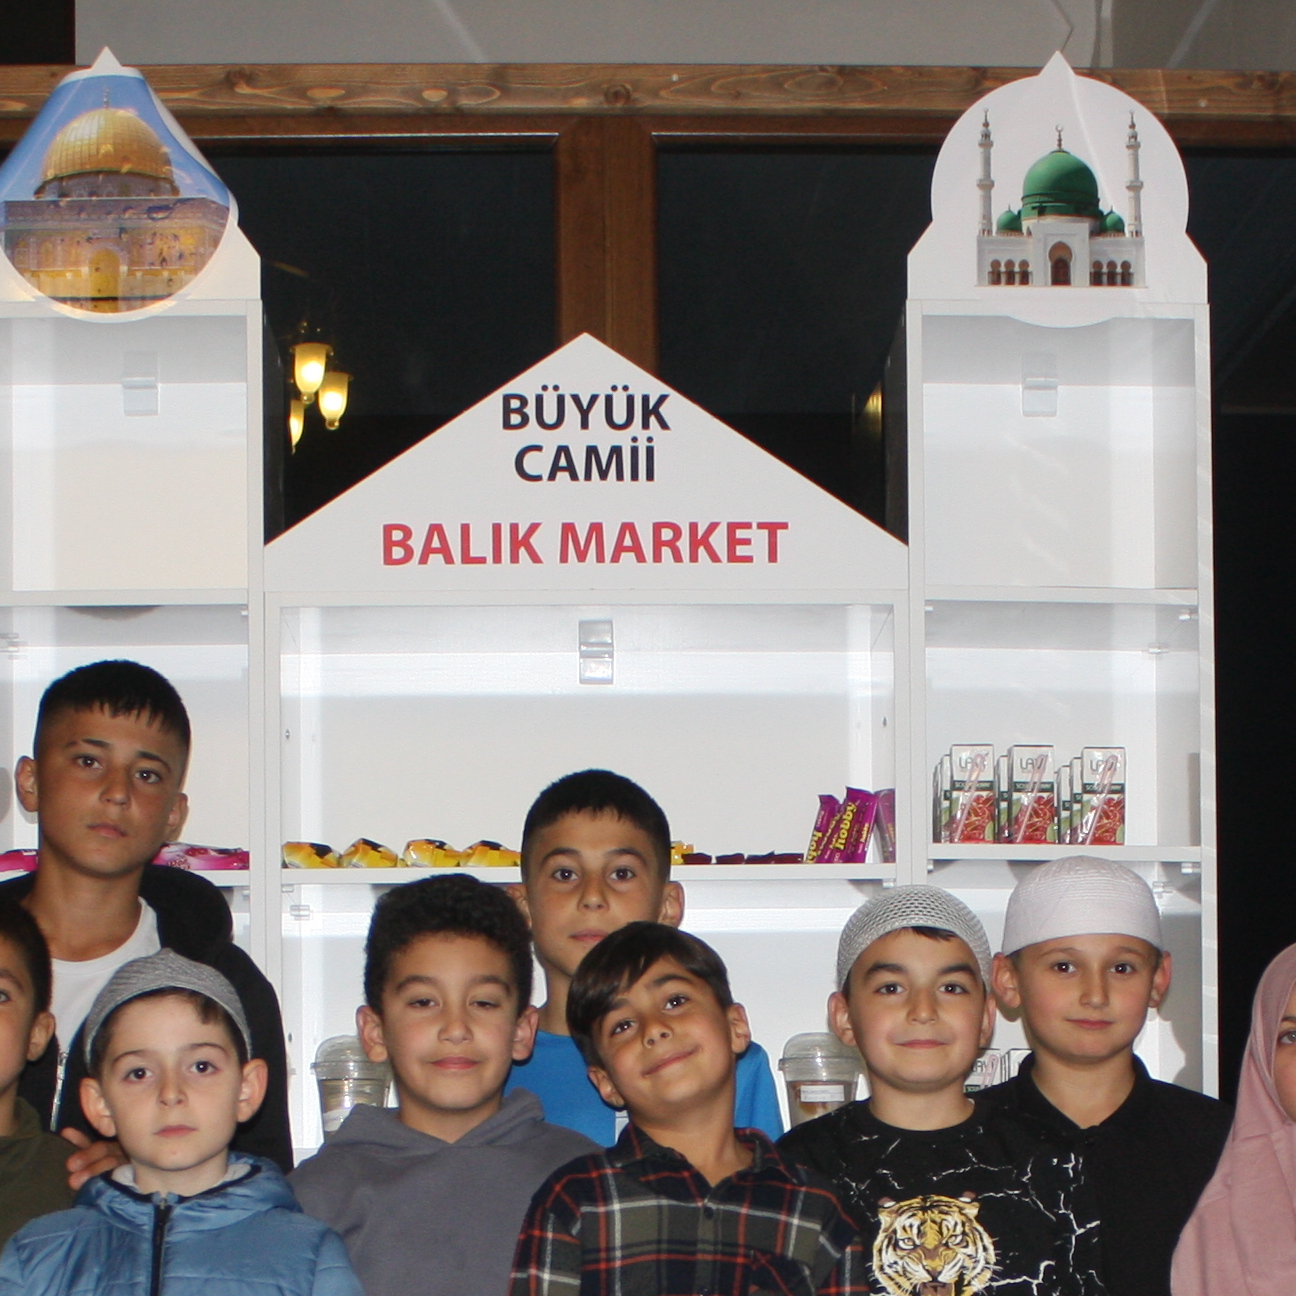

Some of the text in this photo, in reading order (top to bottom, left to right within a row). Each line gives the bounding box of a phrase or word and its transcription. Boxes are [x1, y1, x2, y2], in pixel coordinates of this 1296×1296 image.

[501, 384, 671, 430] BÜYÜK
[382, 521, 789, 566] BALIK MARKET
[834, 802, 857, 850] hobby
